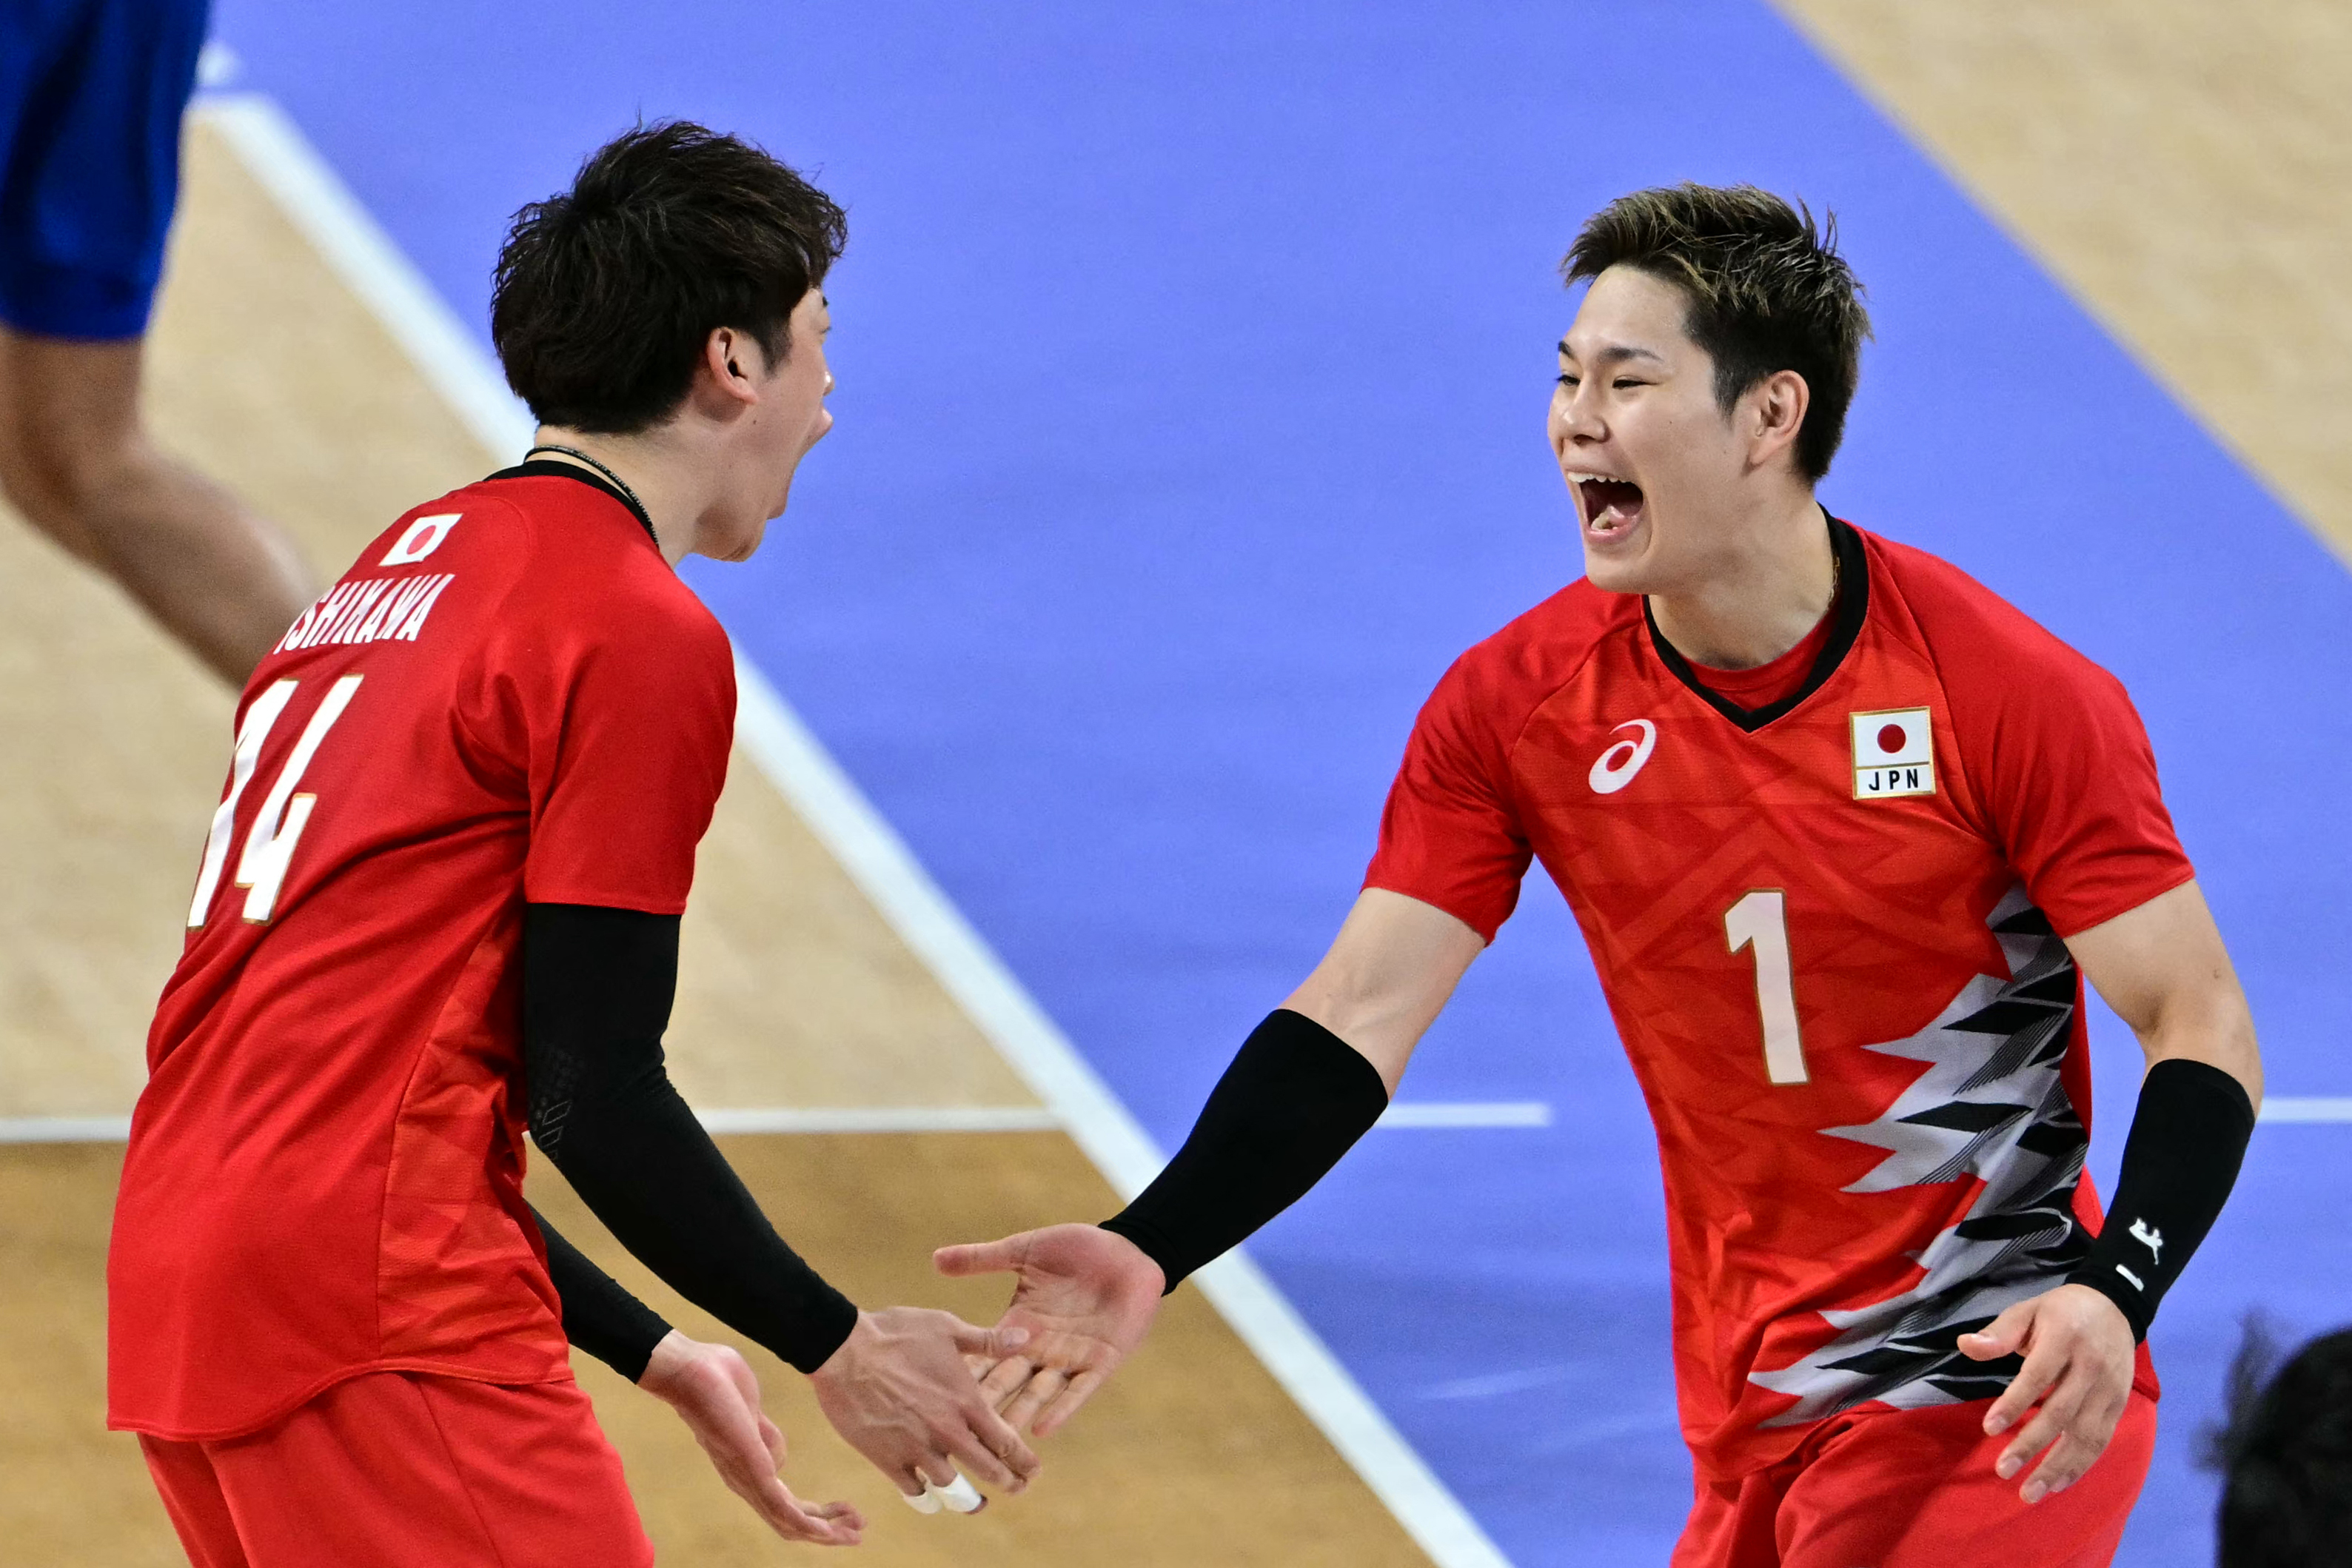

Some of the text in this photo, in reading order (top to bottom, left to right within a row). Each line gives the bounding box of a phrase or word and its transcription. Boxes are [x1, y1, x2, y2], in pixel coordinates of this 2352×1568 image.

[273, 574, 455, 654] ISHIKAWA
[187, 673, 364, 931] 14
[1868, 768, 1919, 791] JPN
[1723, 888, 1810, 1086] 1
